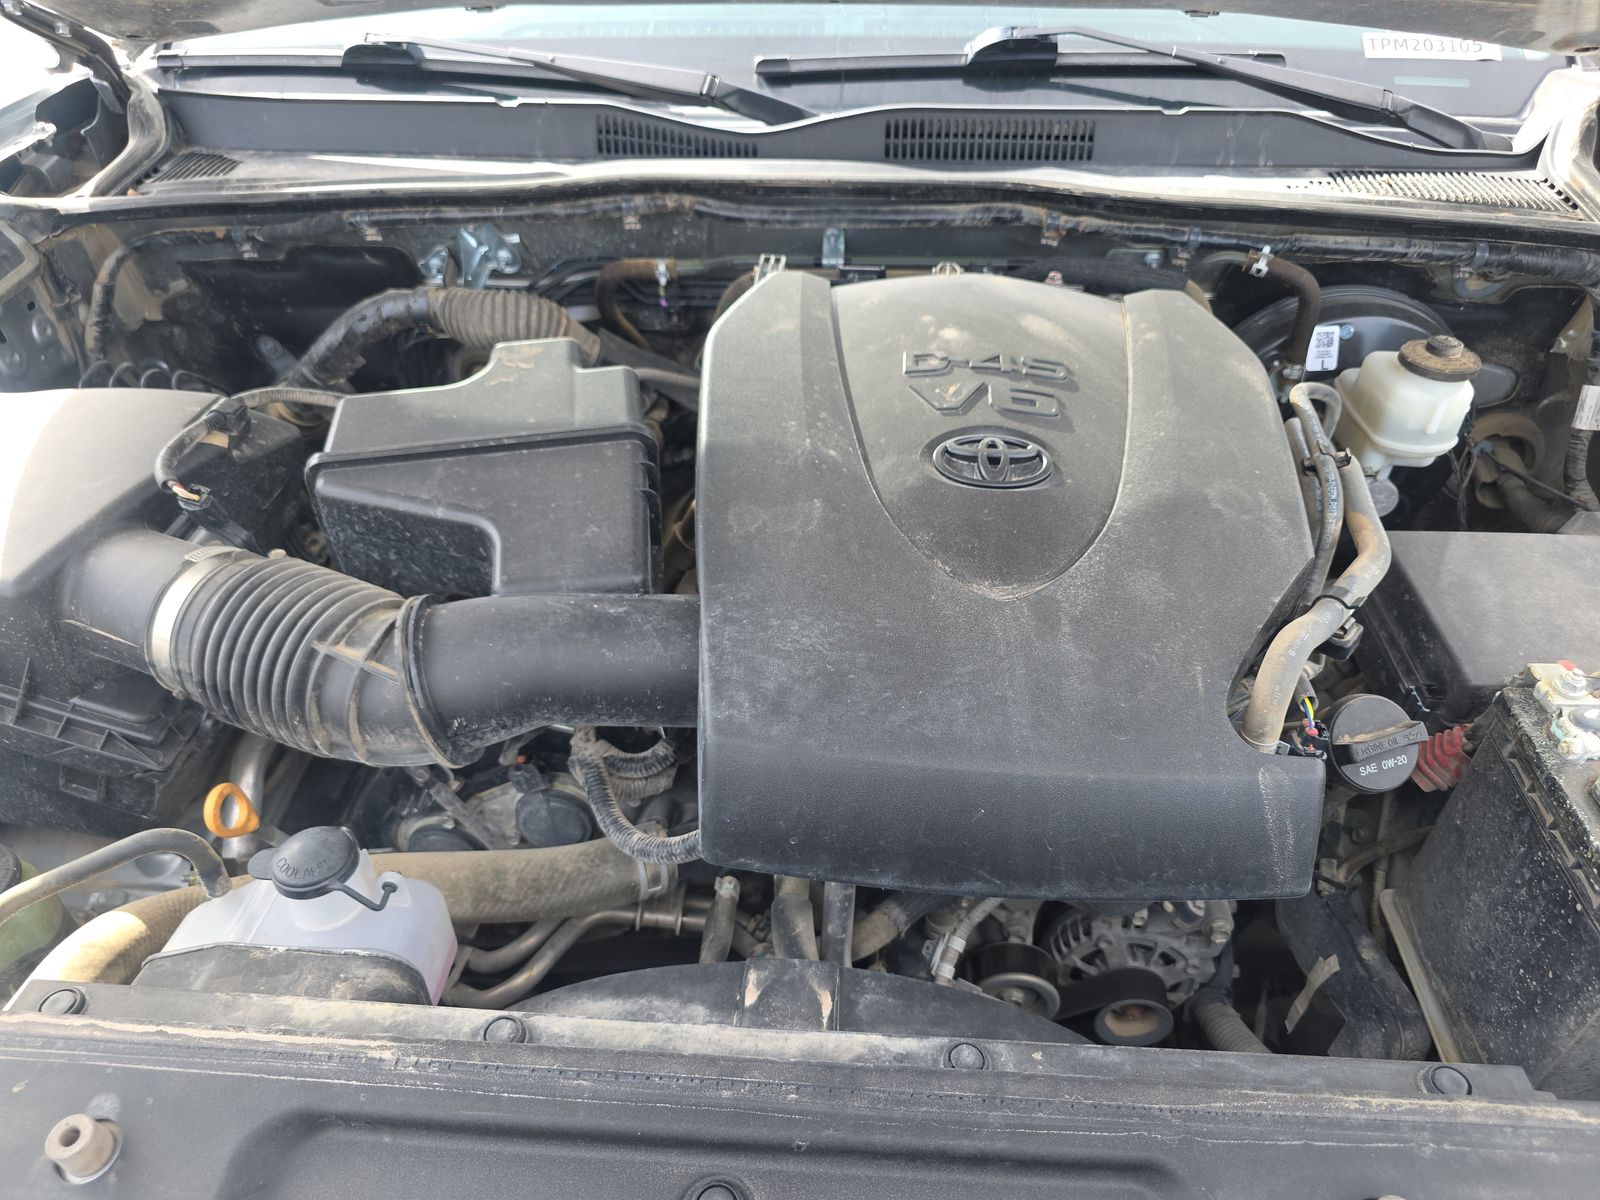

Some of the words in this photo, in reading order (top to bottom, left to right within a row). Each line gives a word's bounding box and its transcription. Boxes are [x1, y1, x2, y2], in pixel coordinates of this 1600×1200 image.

[1368, 37, 1484, 54] TPM203105
[902, 350, 1069, 382] D-4S
[907, 381, 1062, 419] V6
[1354, 741, 1385, 759] ENGINE
[1387, 736, 1399, 748] OIL
[1359, 763, 1379, 776] SAE
[1381, 754, 1408, 770] 0W-20
[276, 857, 330, 880] COOLANT
